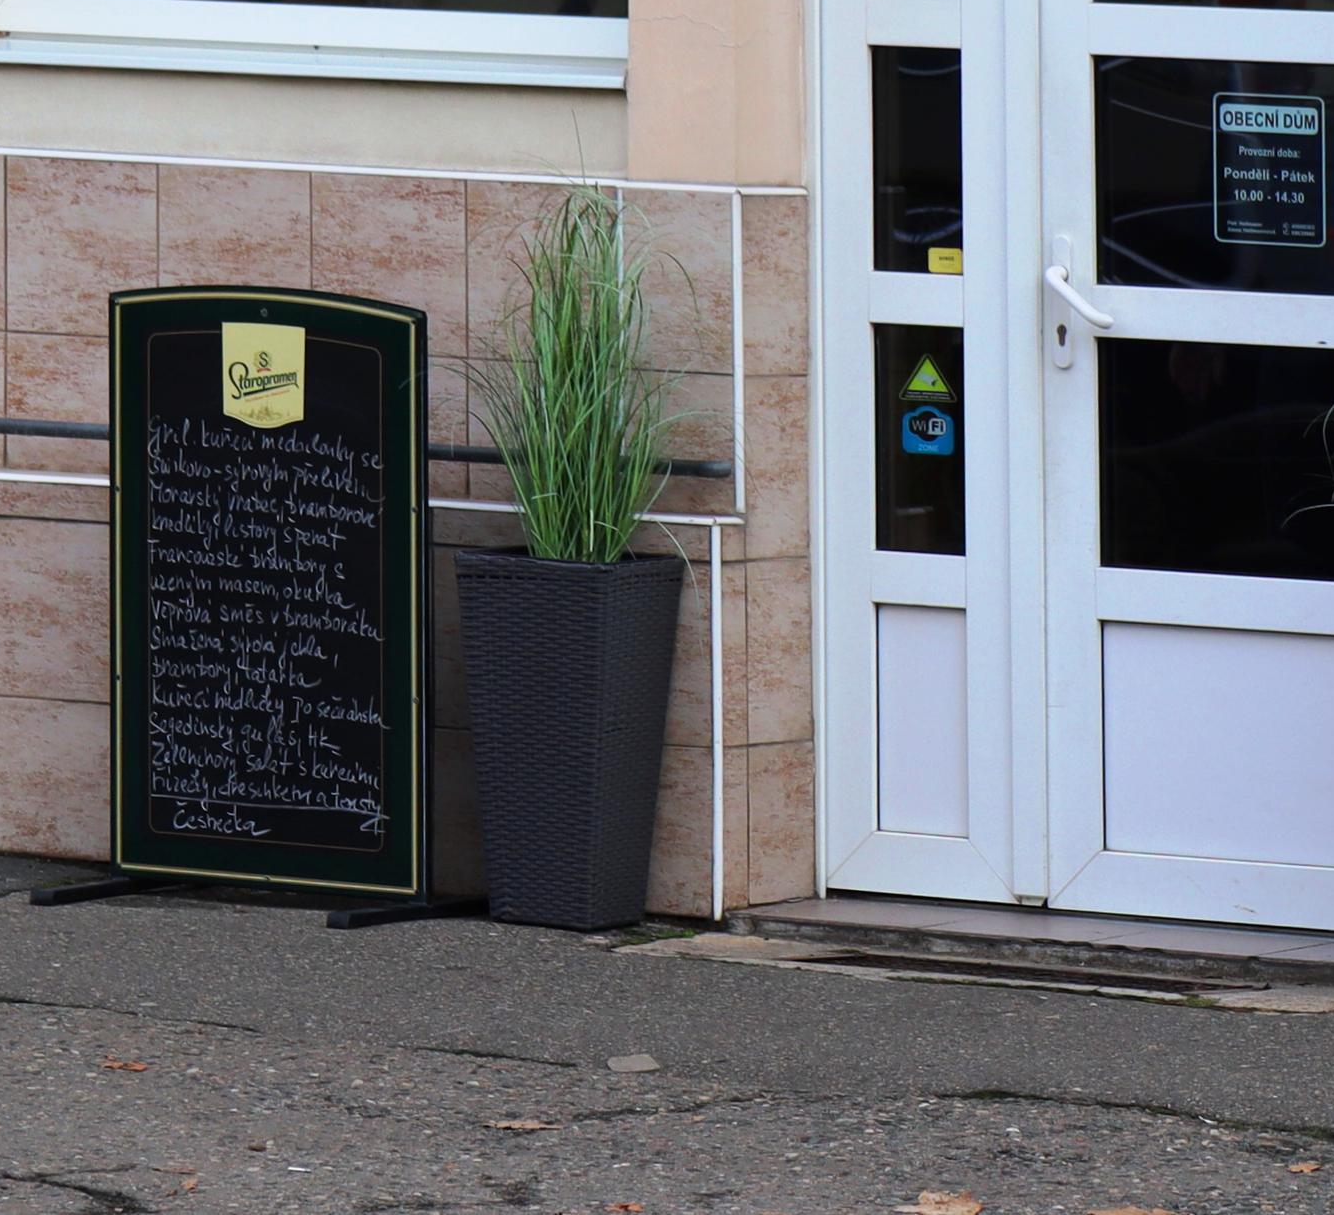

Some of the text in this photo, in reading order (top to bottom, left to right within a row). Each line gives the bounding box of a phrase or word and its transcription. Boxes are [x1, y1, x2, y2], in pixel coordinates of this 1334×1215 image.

[1223, 109, 1315, 130] OBECNÍ DŮM
[1239, 145, 1301, 159] Provozní doba:
[1223, 167, 1270, 181] Pondělí
[1281, 169, 1315, 183] Pátek
[1233, 189, 1263, 201] 10.00
[1275, 191, 1305, 204] 14.30
[228, 361, 298, 400] Staropramen
[361, 453, 385, 470] se
